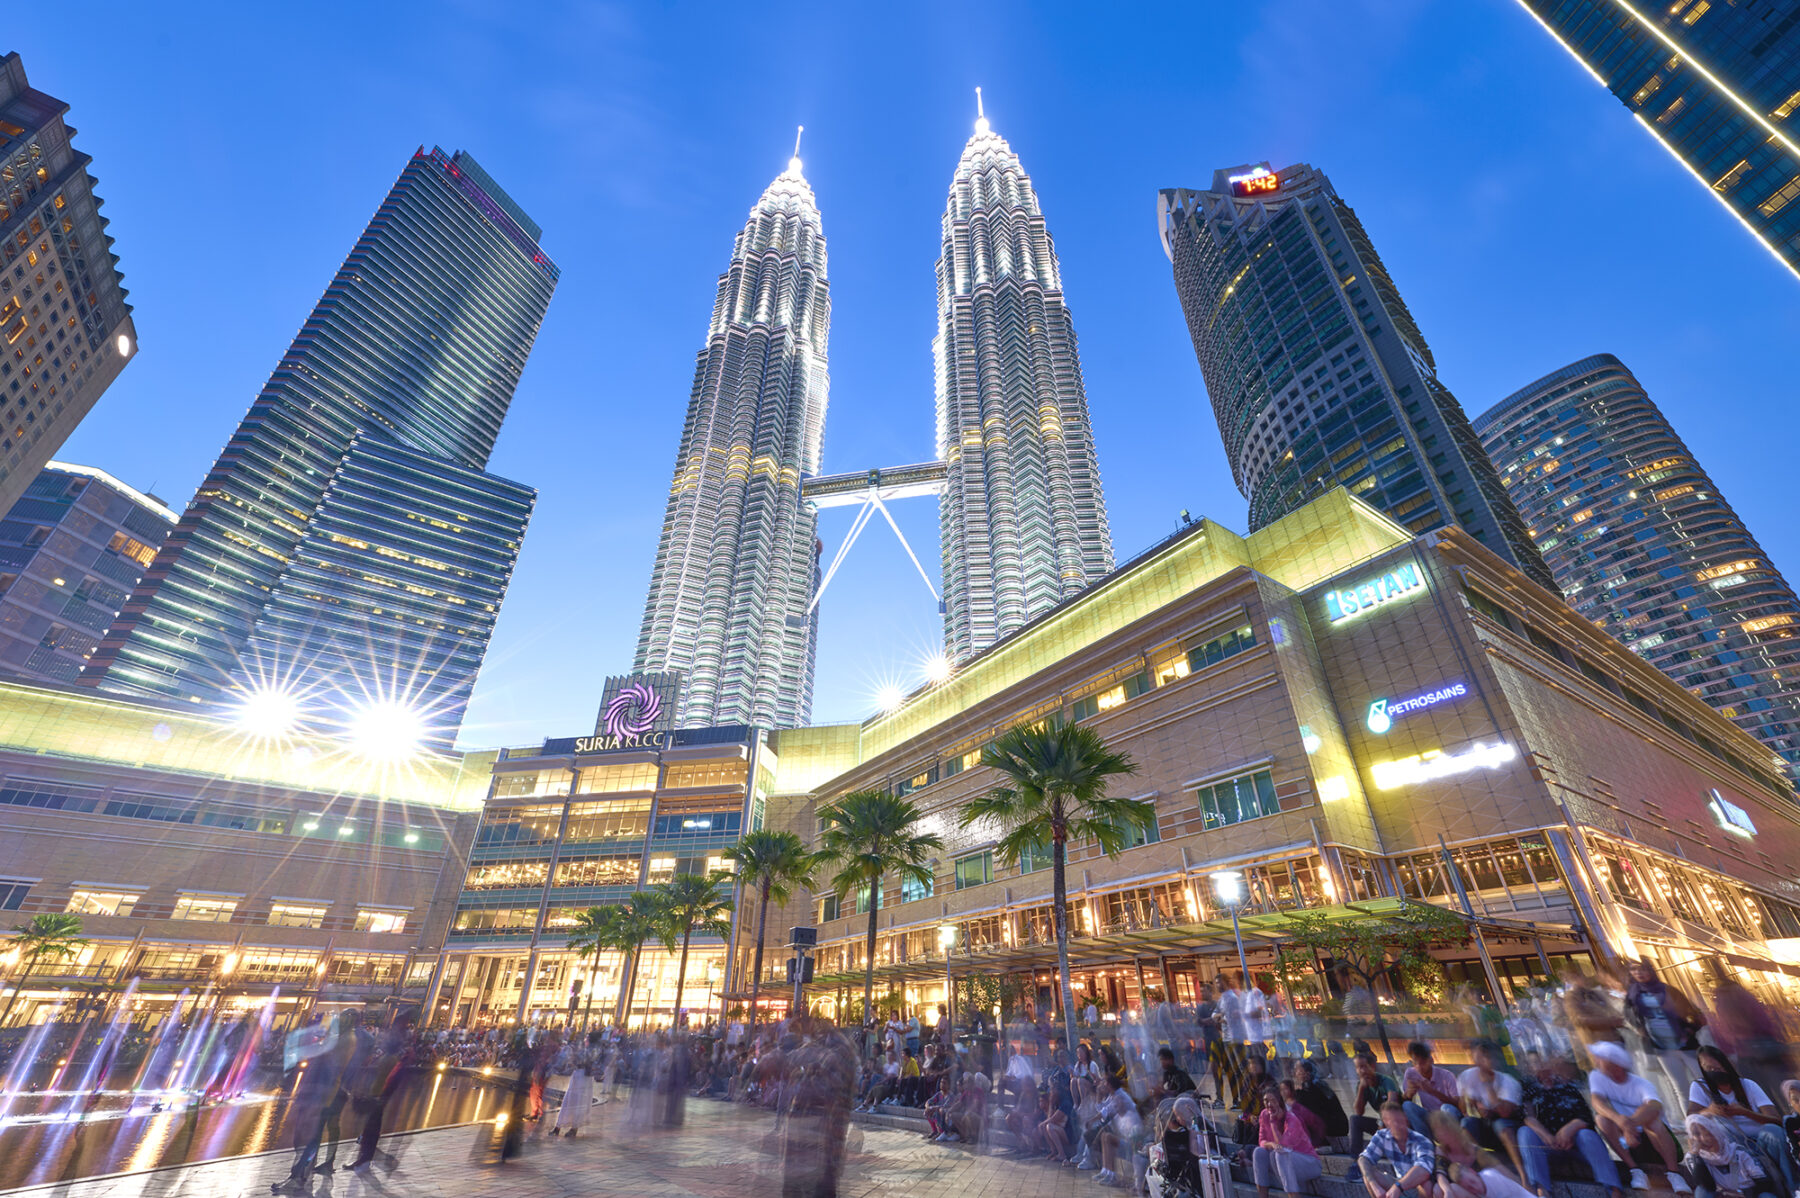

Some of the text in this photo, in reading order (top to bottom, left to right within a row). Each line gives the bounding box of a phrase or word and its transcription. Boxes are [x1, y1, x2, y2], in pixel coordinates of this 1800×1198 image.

[1241, 174, 1277, 192] 7:42
[1387, 684, 1466, 716] PETROSAINS
[574, 732, 664, 752] SURIA KLCC
